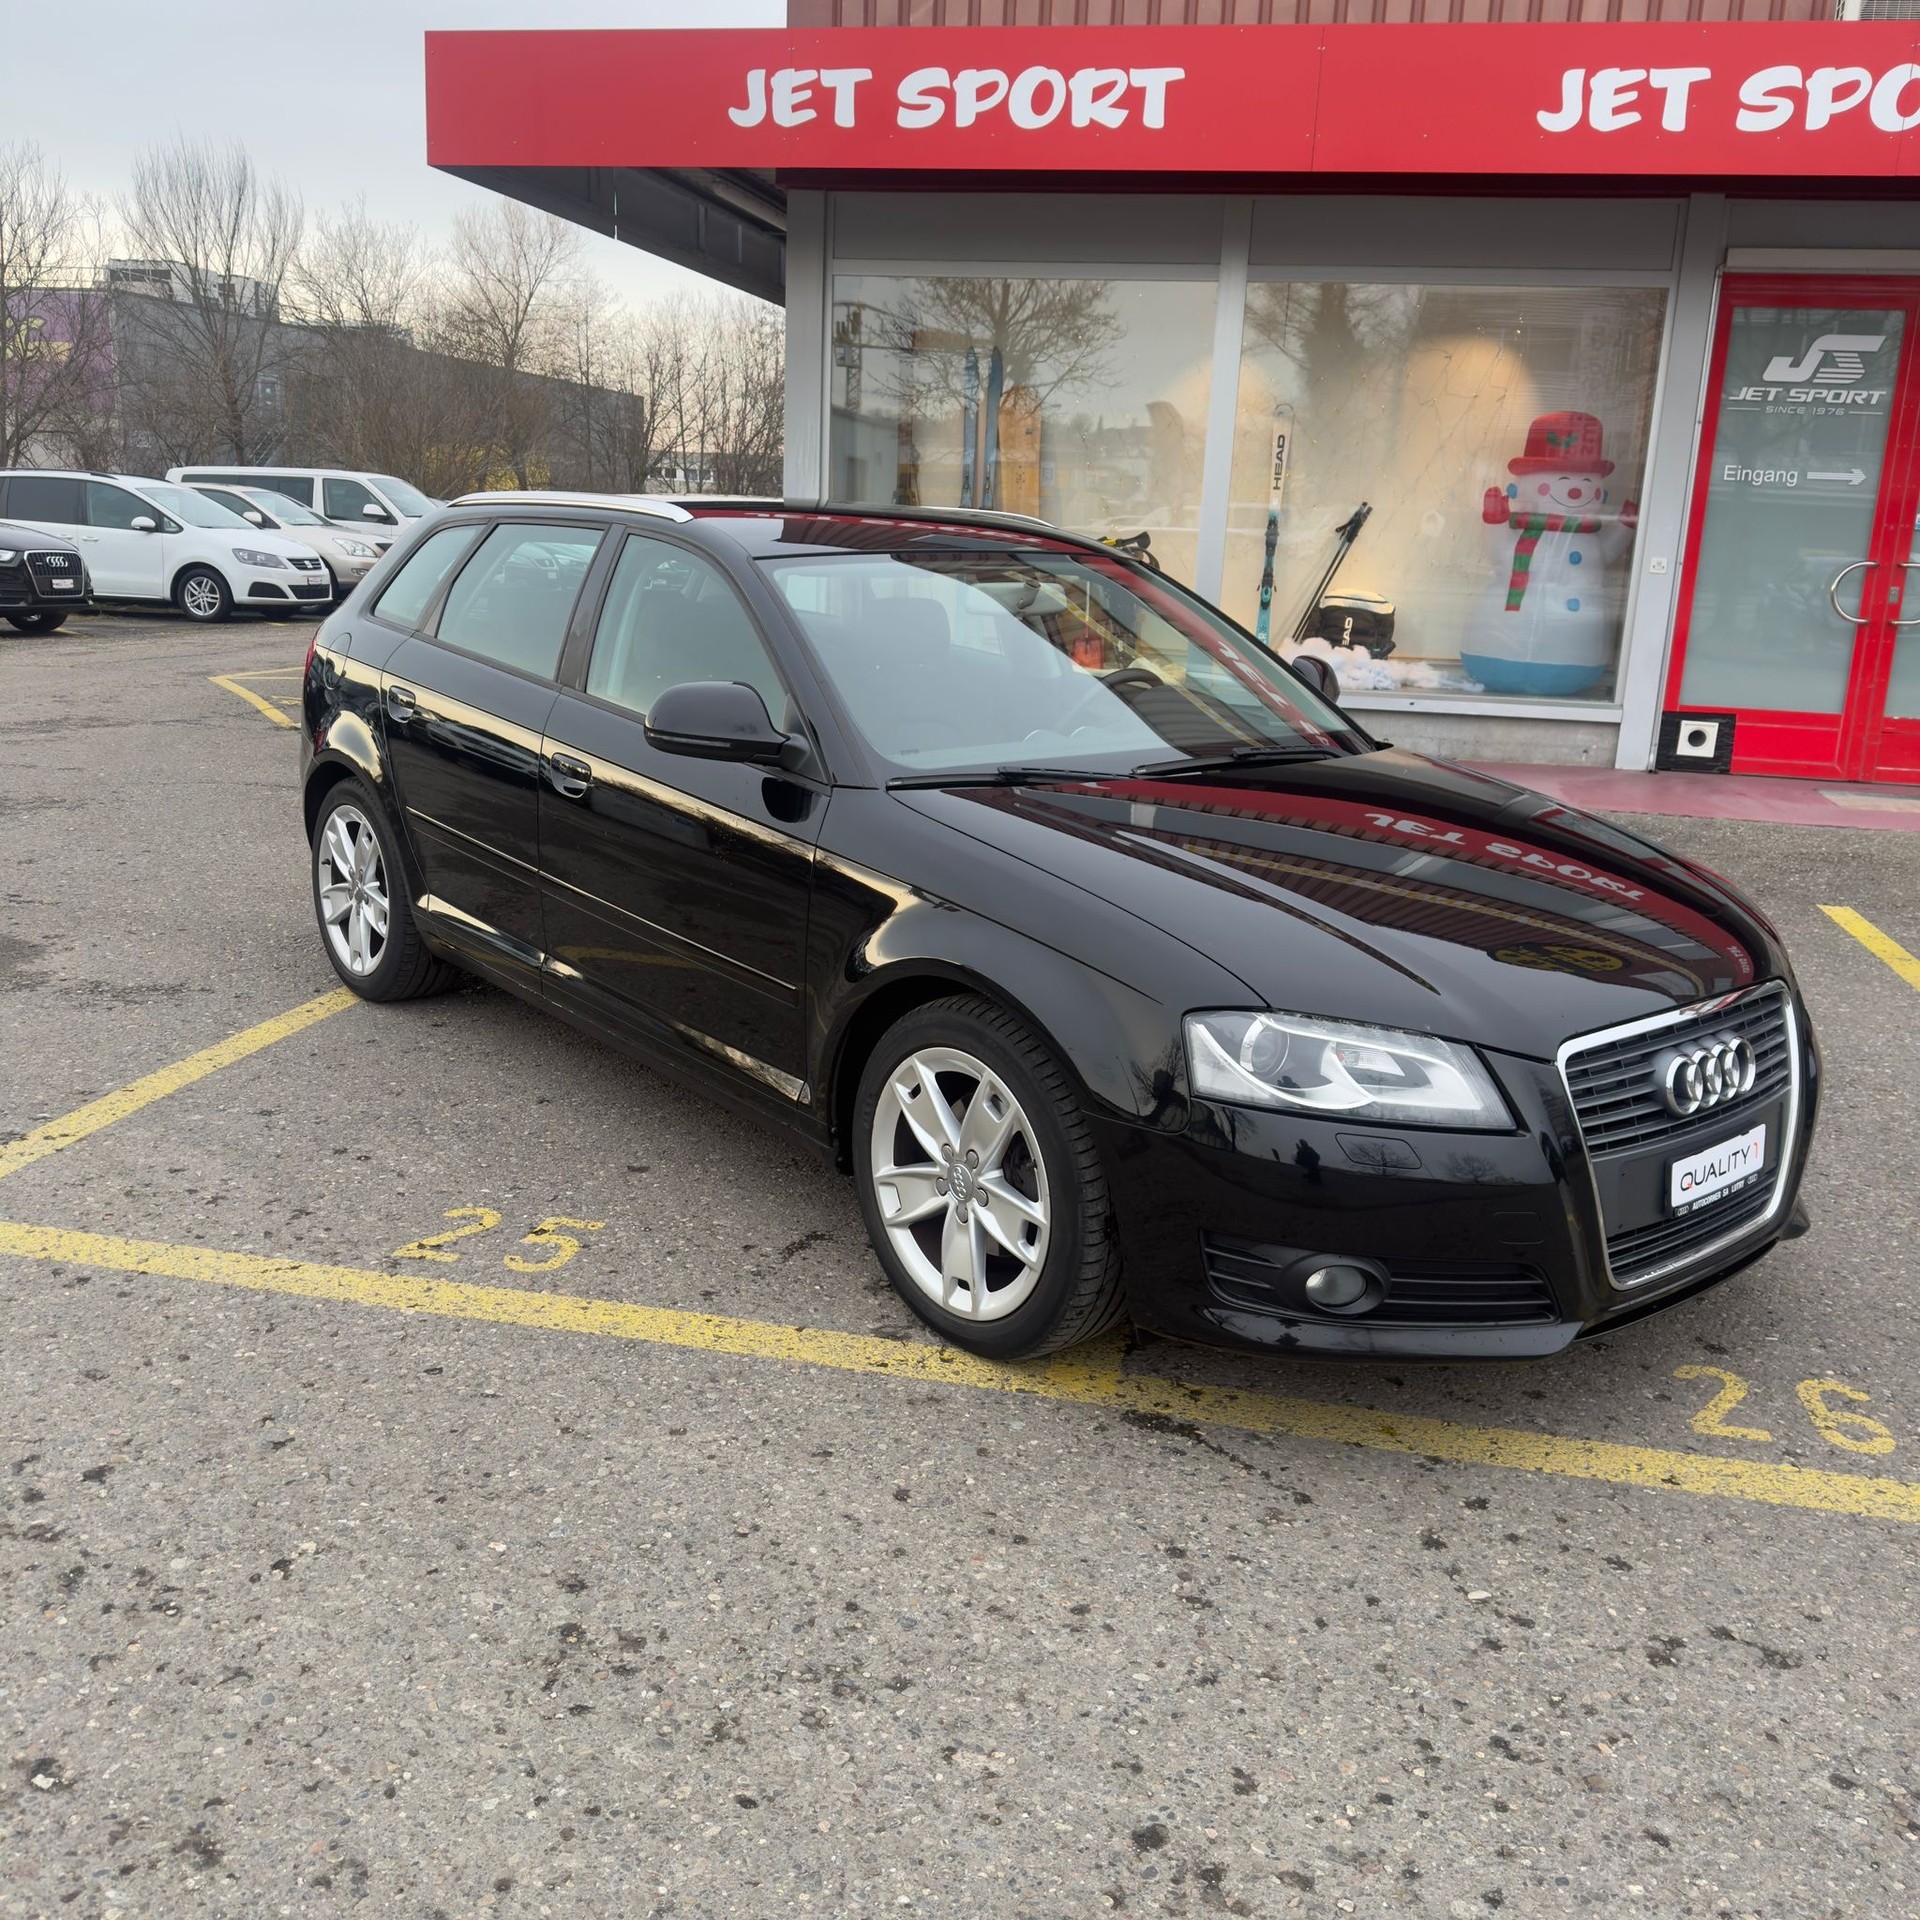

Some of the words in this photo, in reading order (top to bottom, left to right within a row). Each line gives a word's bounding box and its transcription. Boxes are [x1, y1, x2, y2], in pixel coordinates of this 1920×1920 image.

[728, 68, 873, 128] JET
[897, 66, 1185, 129] SPORT
[1536, 67, 1711, 132] JET
[1728, 386, 1783, 401] JET
[1786, 388, 1886, 404] SPORT
[1765, 406, 1806, 414] SINCE
[1812, 407, 1845, 416] 1976
[1273, 434, 1285, 490] HEAD
[1723, 464, 1798, 486] Eingang
[393, 1207, 606, 1273] 25
[1672, 1364, 1897, 1455] 26
